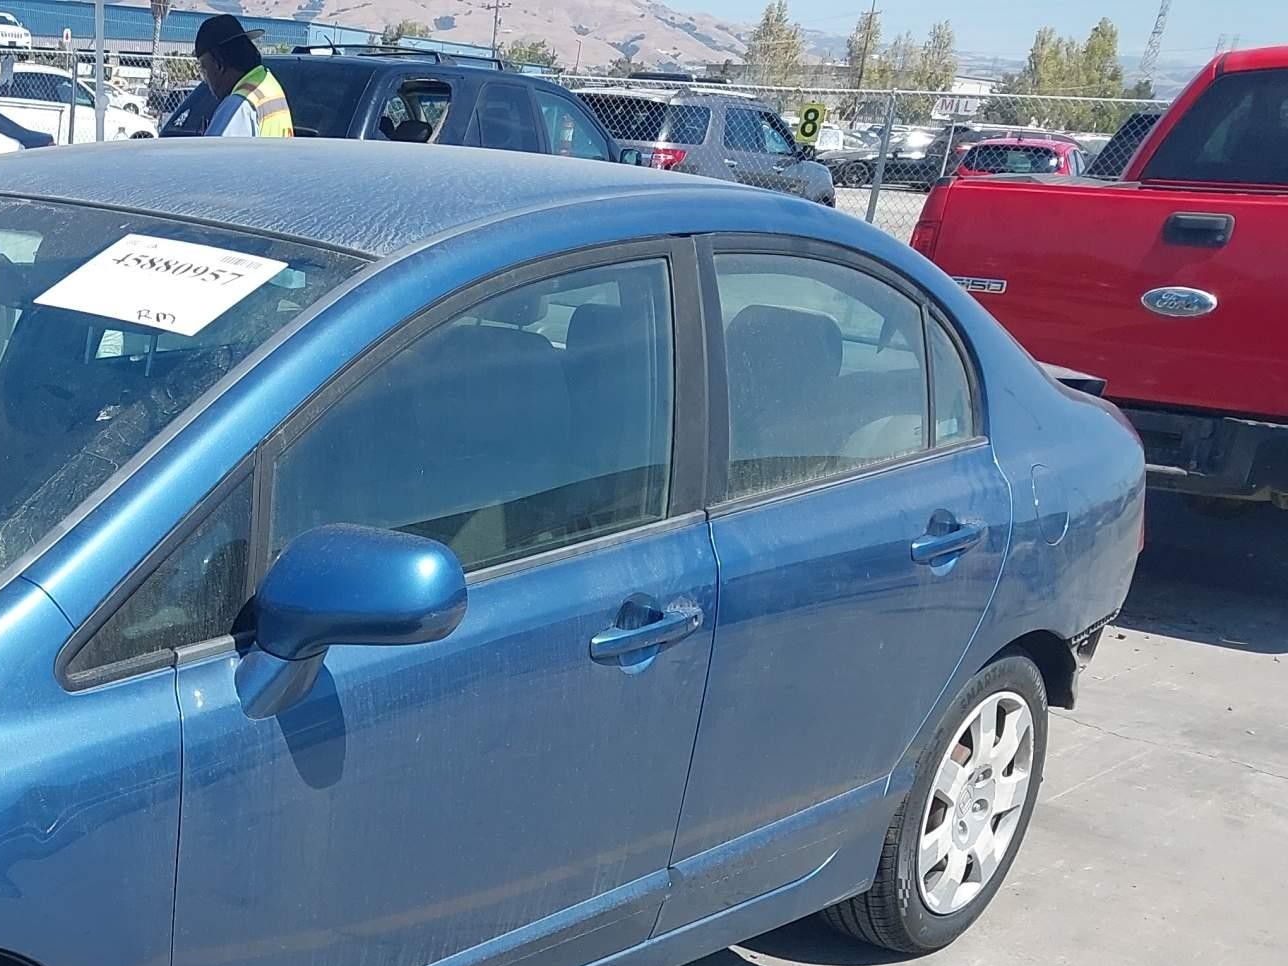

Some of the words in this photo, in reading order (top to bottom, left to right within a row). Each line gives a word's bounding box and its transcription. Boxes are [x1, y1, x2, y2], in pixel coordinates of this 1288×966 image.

[800, 108, 820, 138] 8
[112, 253, 245, 286] 45880957
[1155, 290, 1201, 312] Ford
